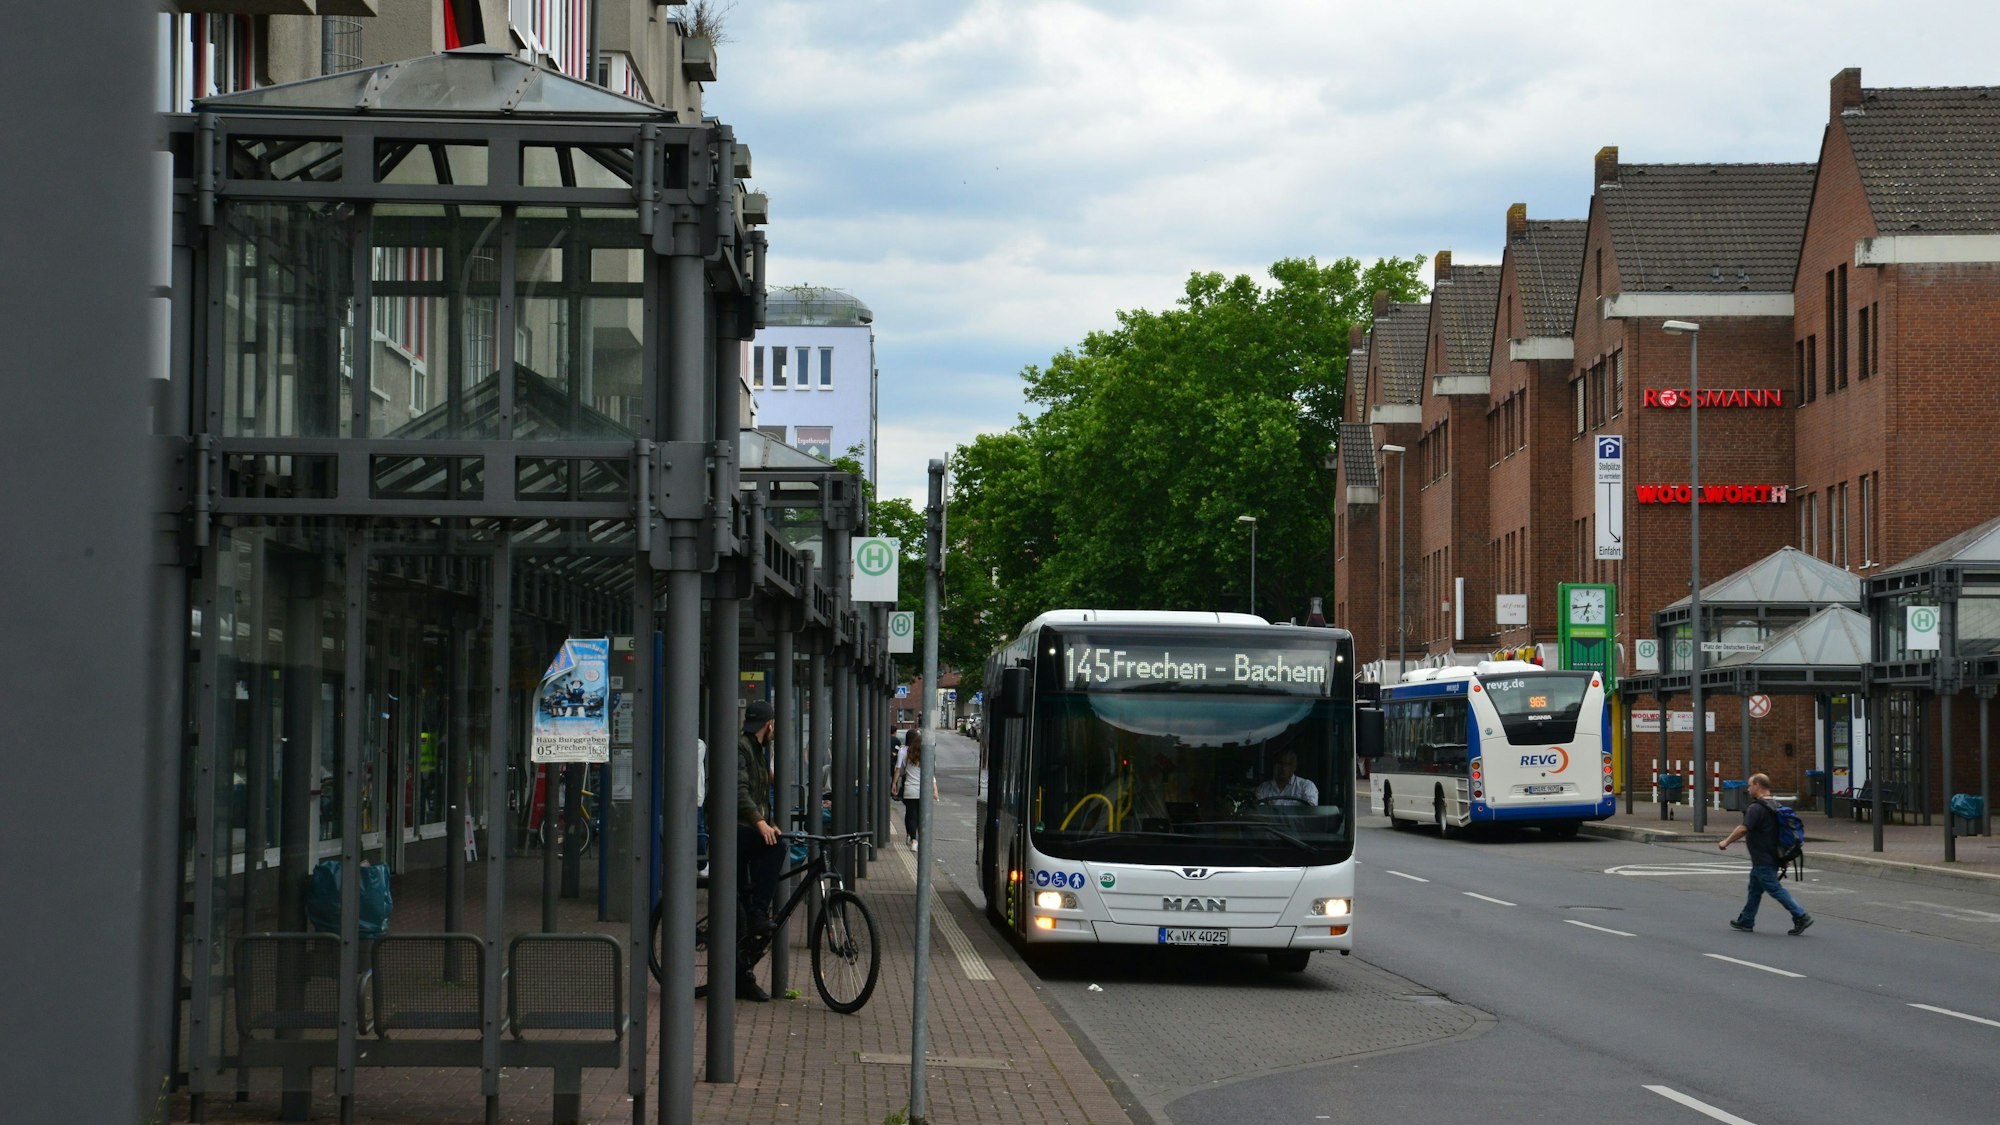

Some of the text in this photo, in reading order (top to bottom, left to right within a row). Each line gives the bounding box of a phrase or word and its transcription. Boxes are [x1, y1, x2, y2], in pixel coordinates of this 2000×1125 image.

[1643, 388, 1782, 408] ROSSMANN
[797, 437, 830, 446] Ergotherapie
[1605, 444, 1615, 458] P
[1599, 462, 1621, 472] Stellplätze
[866, 547, 884, 568] H
[1599, 546, 1621, 556] Einfahrt
[896, 618, 906, 632] H
[1917, 613, 1929, 627] H
[1643, 645, 1651, 654] H
[1234, 653, 1325, 682] Bachem
[1486, 678, 1525, 690] revg.de
[1529, 696, 1547, 709] 965
[558, 736, 607, 744] Burggraben
[537, 745, 556, 756] 05.
[1520, 754, 1557, 766] REVG
[1162, 897, 1227, 912] MAN
[1167, 930, 1227, 943] K VK 4025
